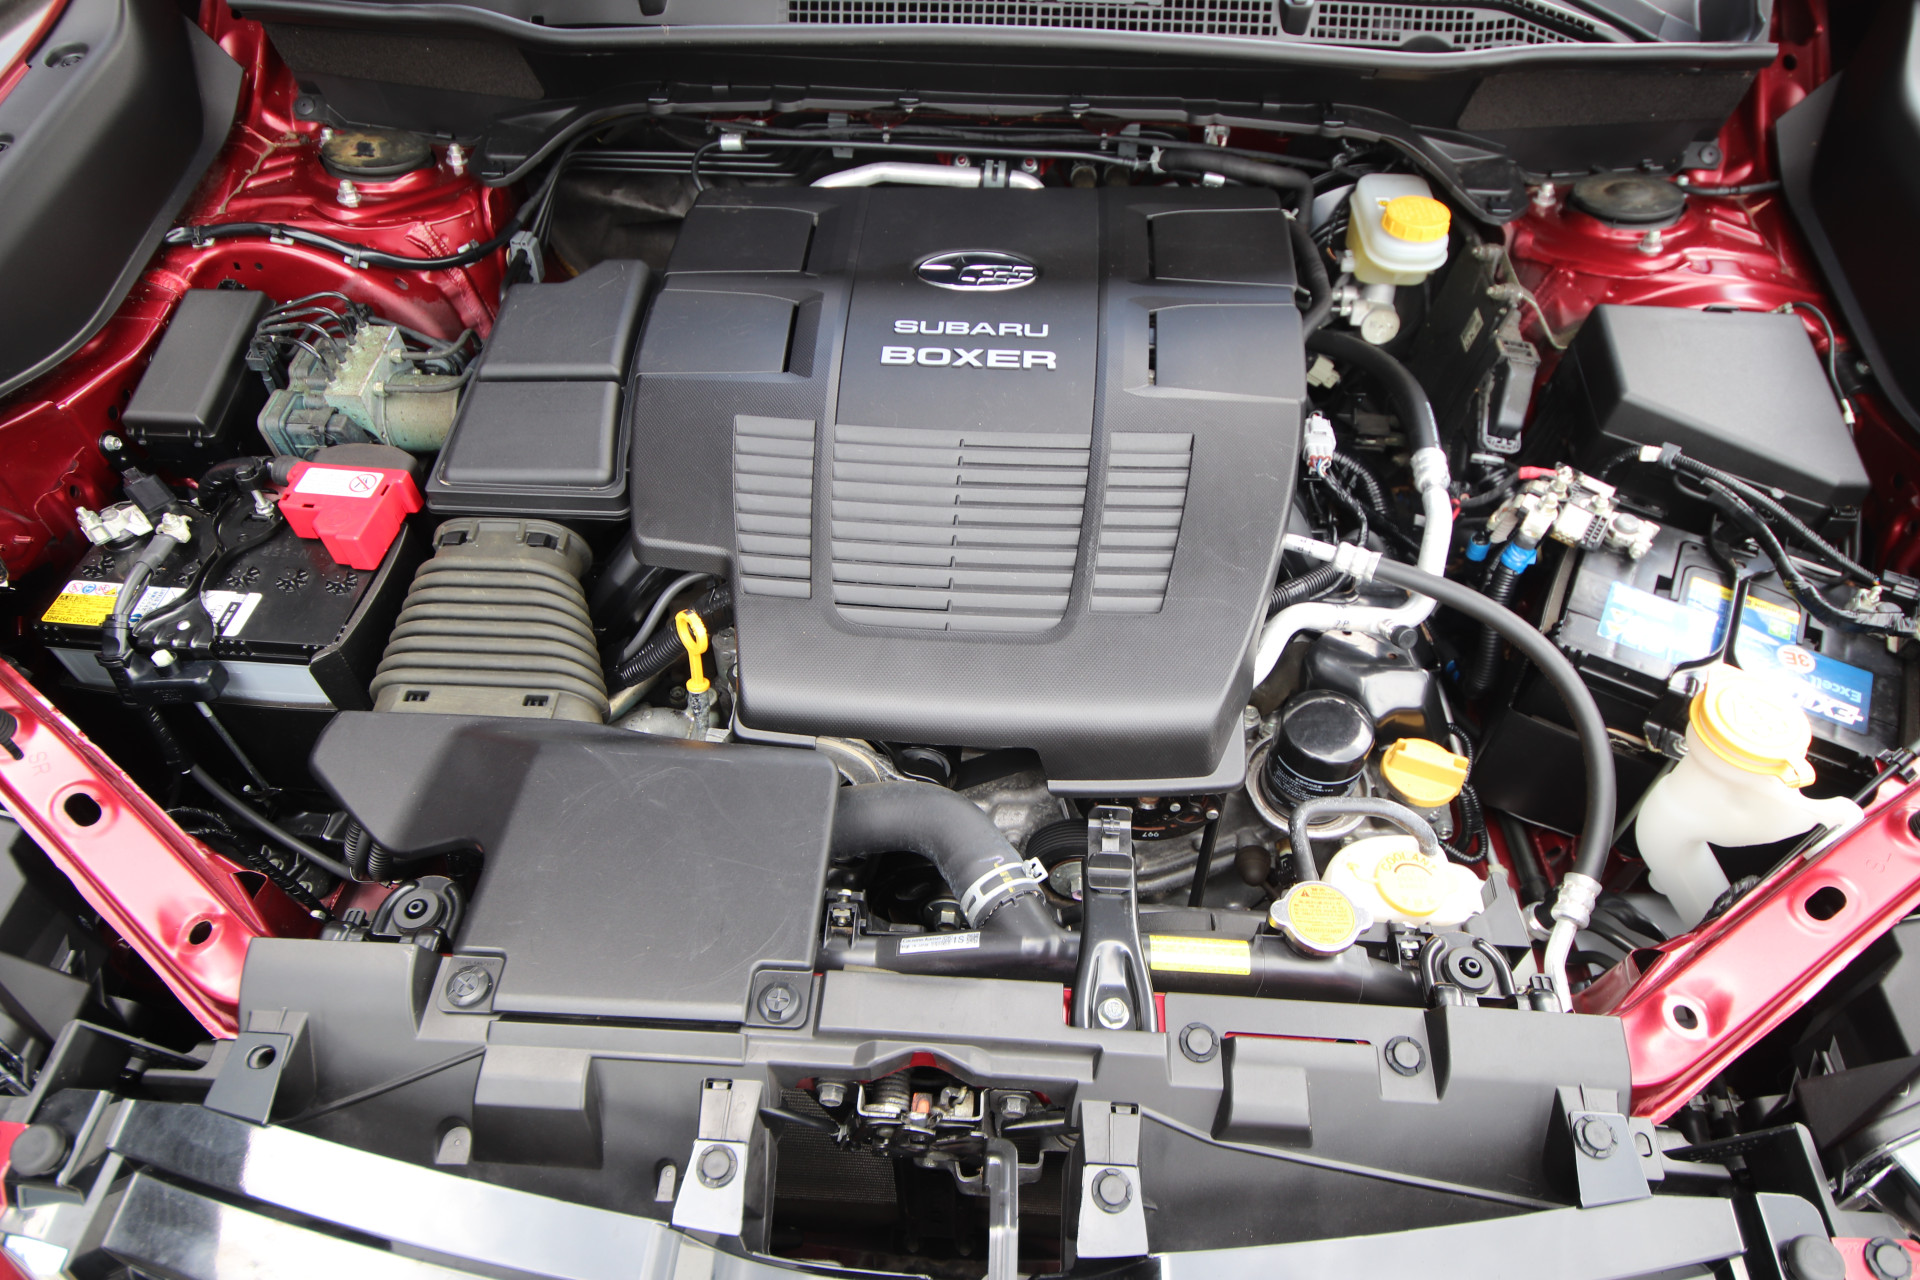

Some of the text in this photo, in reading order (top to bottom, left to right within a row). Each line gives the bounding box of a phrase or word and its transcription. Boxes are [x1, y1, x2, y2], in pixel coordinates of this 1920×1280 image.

[894, 319, 1049, 338] SUBARU
[880, 345, 1057, 370] BOXER
[1783, 650, 1811, 668] 3E
